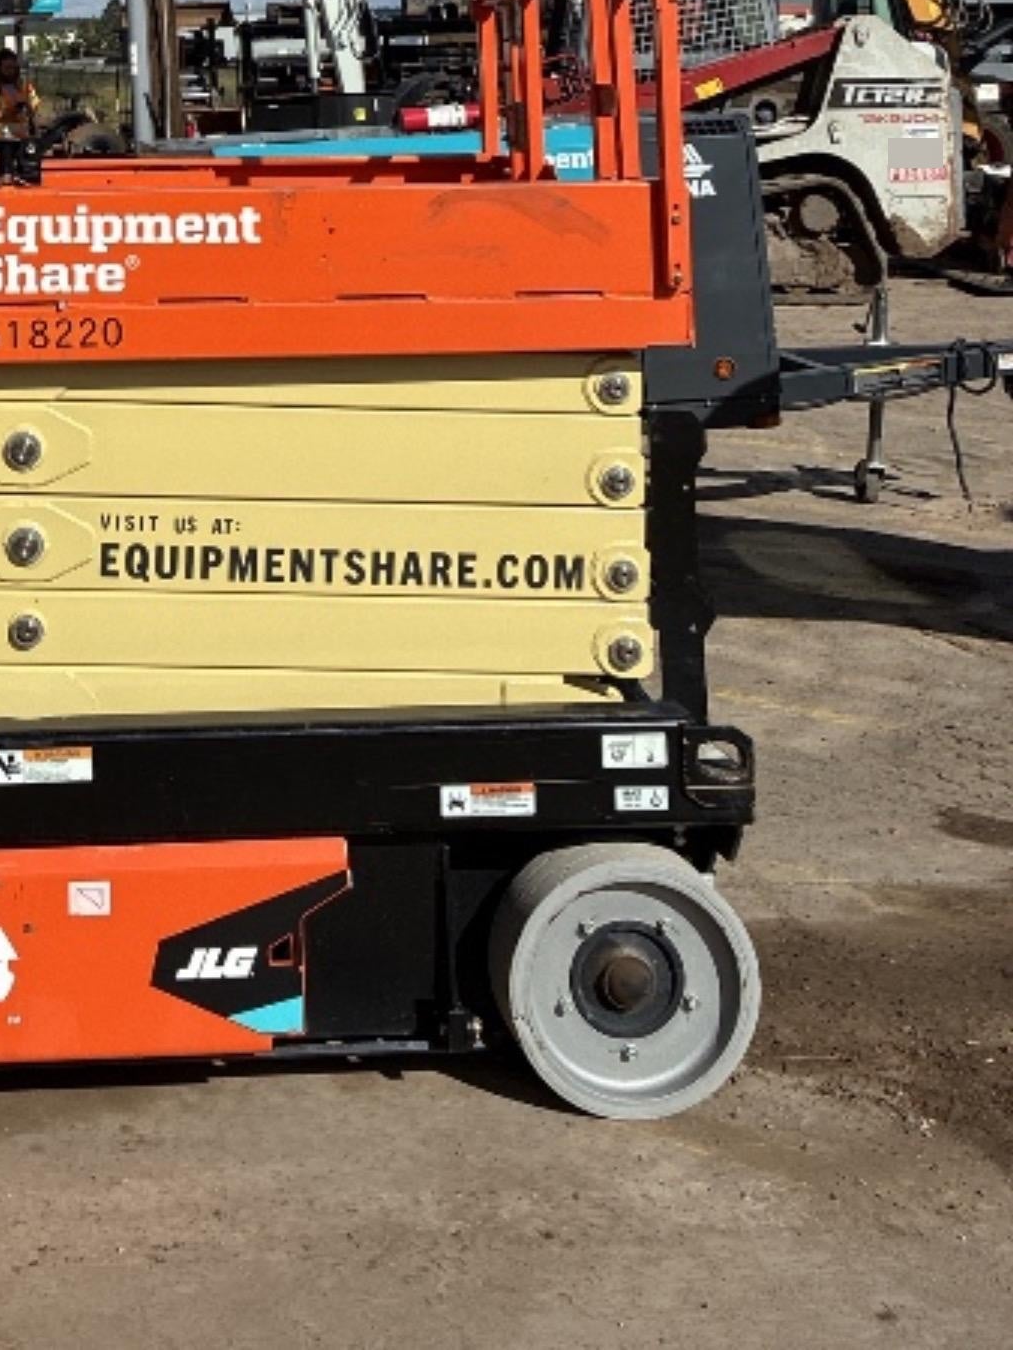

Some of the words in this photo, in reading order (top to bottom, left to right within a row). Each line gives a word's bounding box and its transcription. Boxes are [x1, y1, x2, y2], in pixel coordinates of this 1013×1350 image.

[99, 512, 160, 532] VISIT
[173, 515, 198, 535] US
[211, 517, 242, 536] AT:
[99, 541, 586, 592] EQUIPMENTSHARE.COM
[175, 946, 258, 982] JLG
